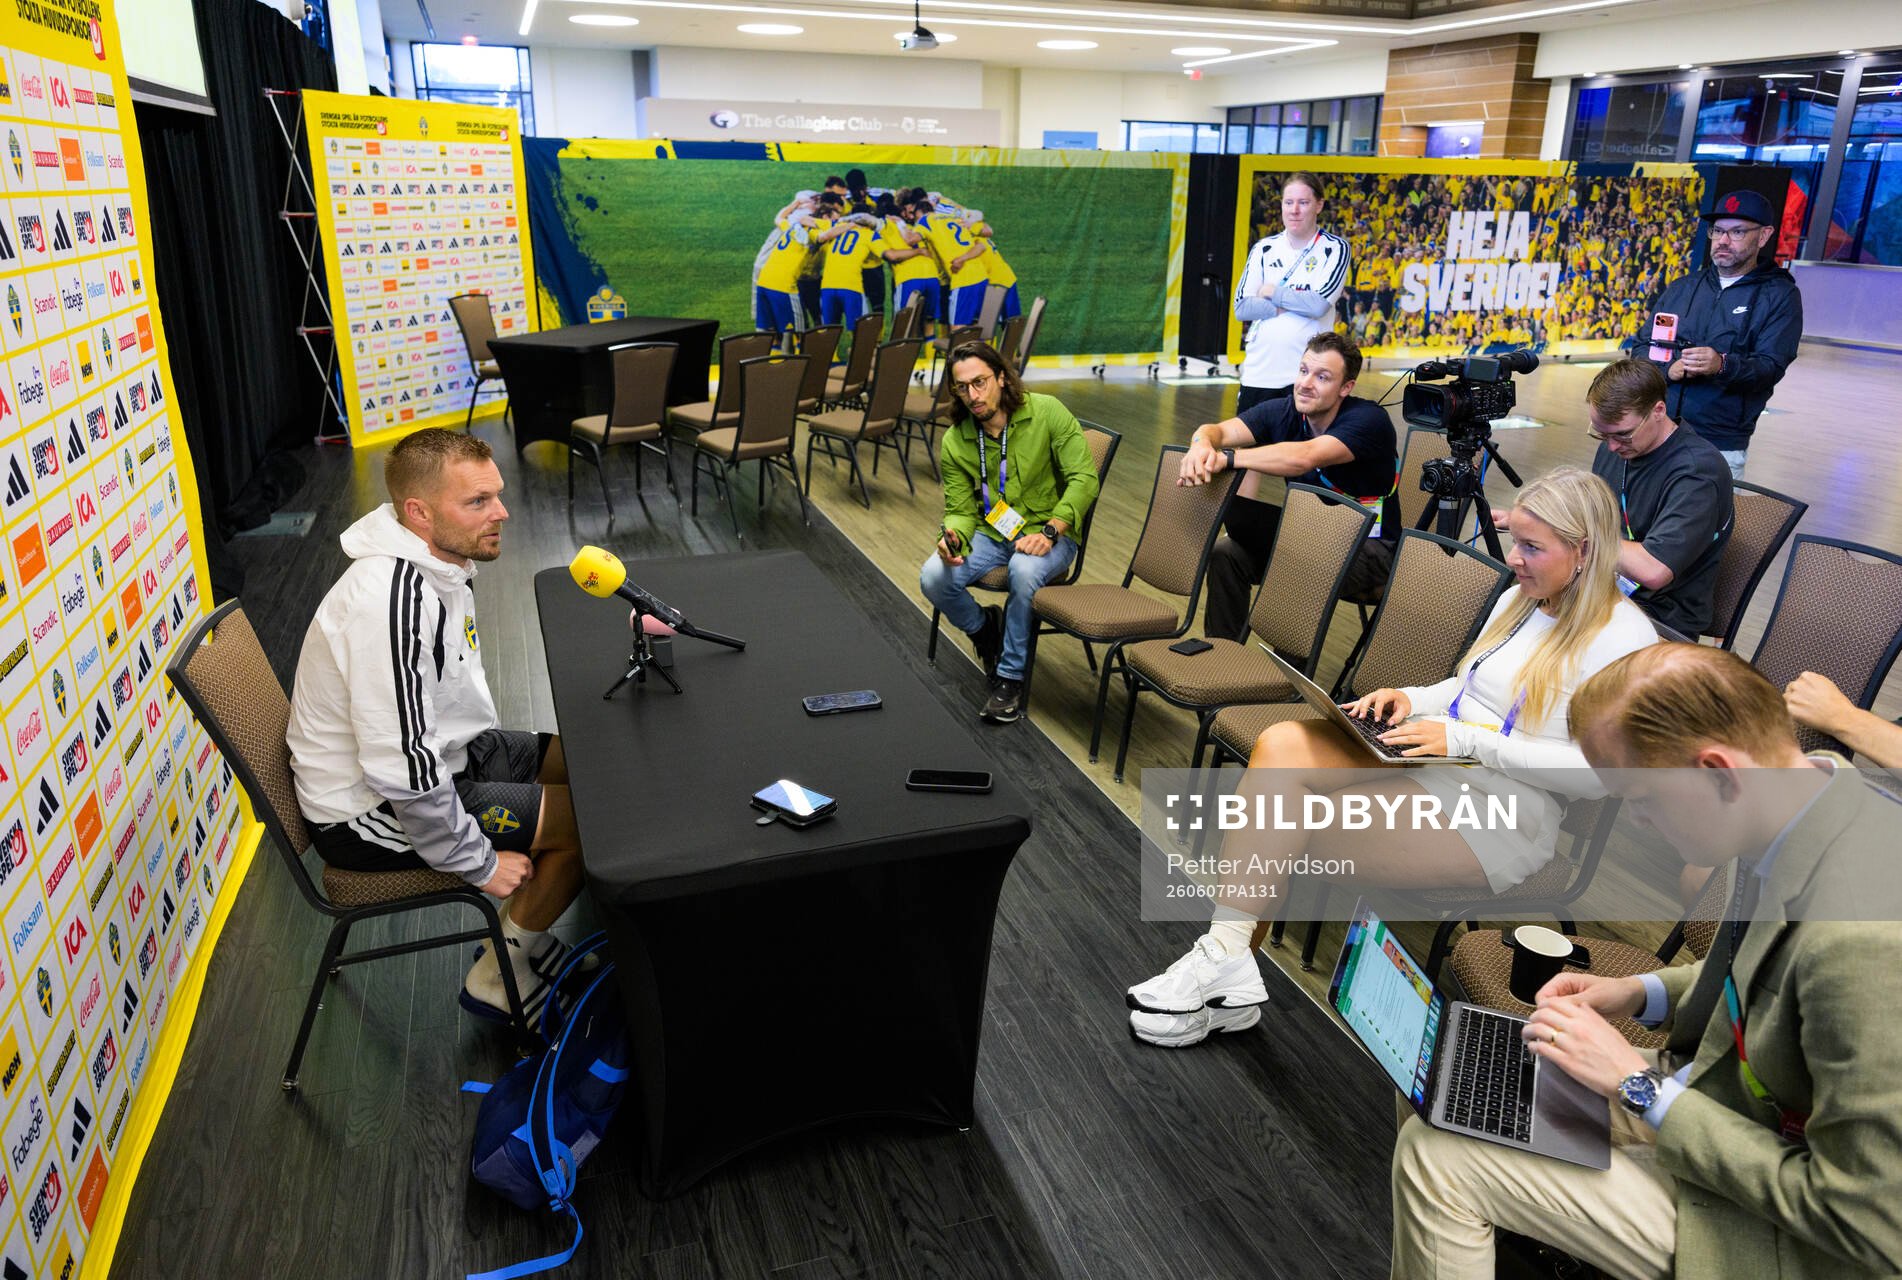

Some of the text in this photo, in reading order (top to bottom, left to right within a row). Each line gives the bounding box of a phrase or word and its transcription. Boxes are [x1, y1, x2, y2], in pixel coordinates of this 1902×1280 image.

[50, 76, 70, 109] ICA
[742, 114, 772, 128] The
[775, 115, 845, 132] Gallagher
[848, 117, 882, 131] Club
[947, 222, 970, 246] 2
[1446, 210, 1530, 259] HEJA
[109, 269, 126, 298] ICA
[1401, 262, 1561, 313] SVERIGE!
[35, 458, 50, 480] SPEL
[76, 492, 96, 527] ICA
[142, 567, 158, 599] ICA
[146, 699, 161, 733] ICA
[46, 842, 75, 898] BAUHAUS
[128, 880, 146, 923] ICA
[12, 900, 43, 955] Folksam
[63, 914, 88, 966] ICA
[12, 1107, 44, 1172] Fabege
[32, 1207, 50, 1244] SPEL
